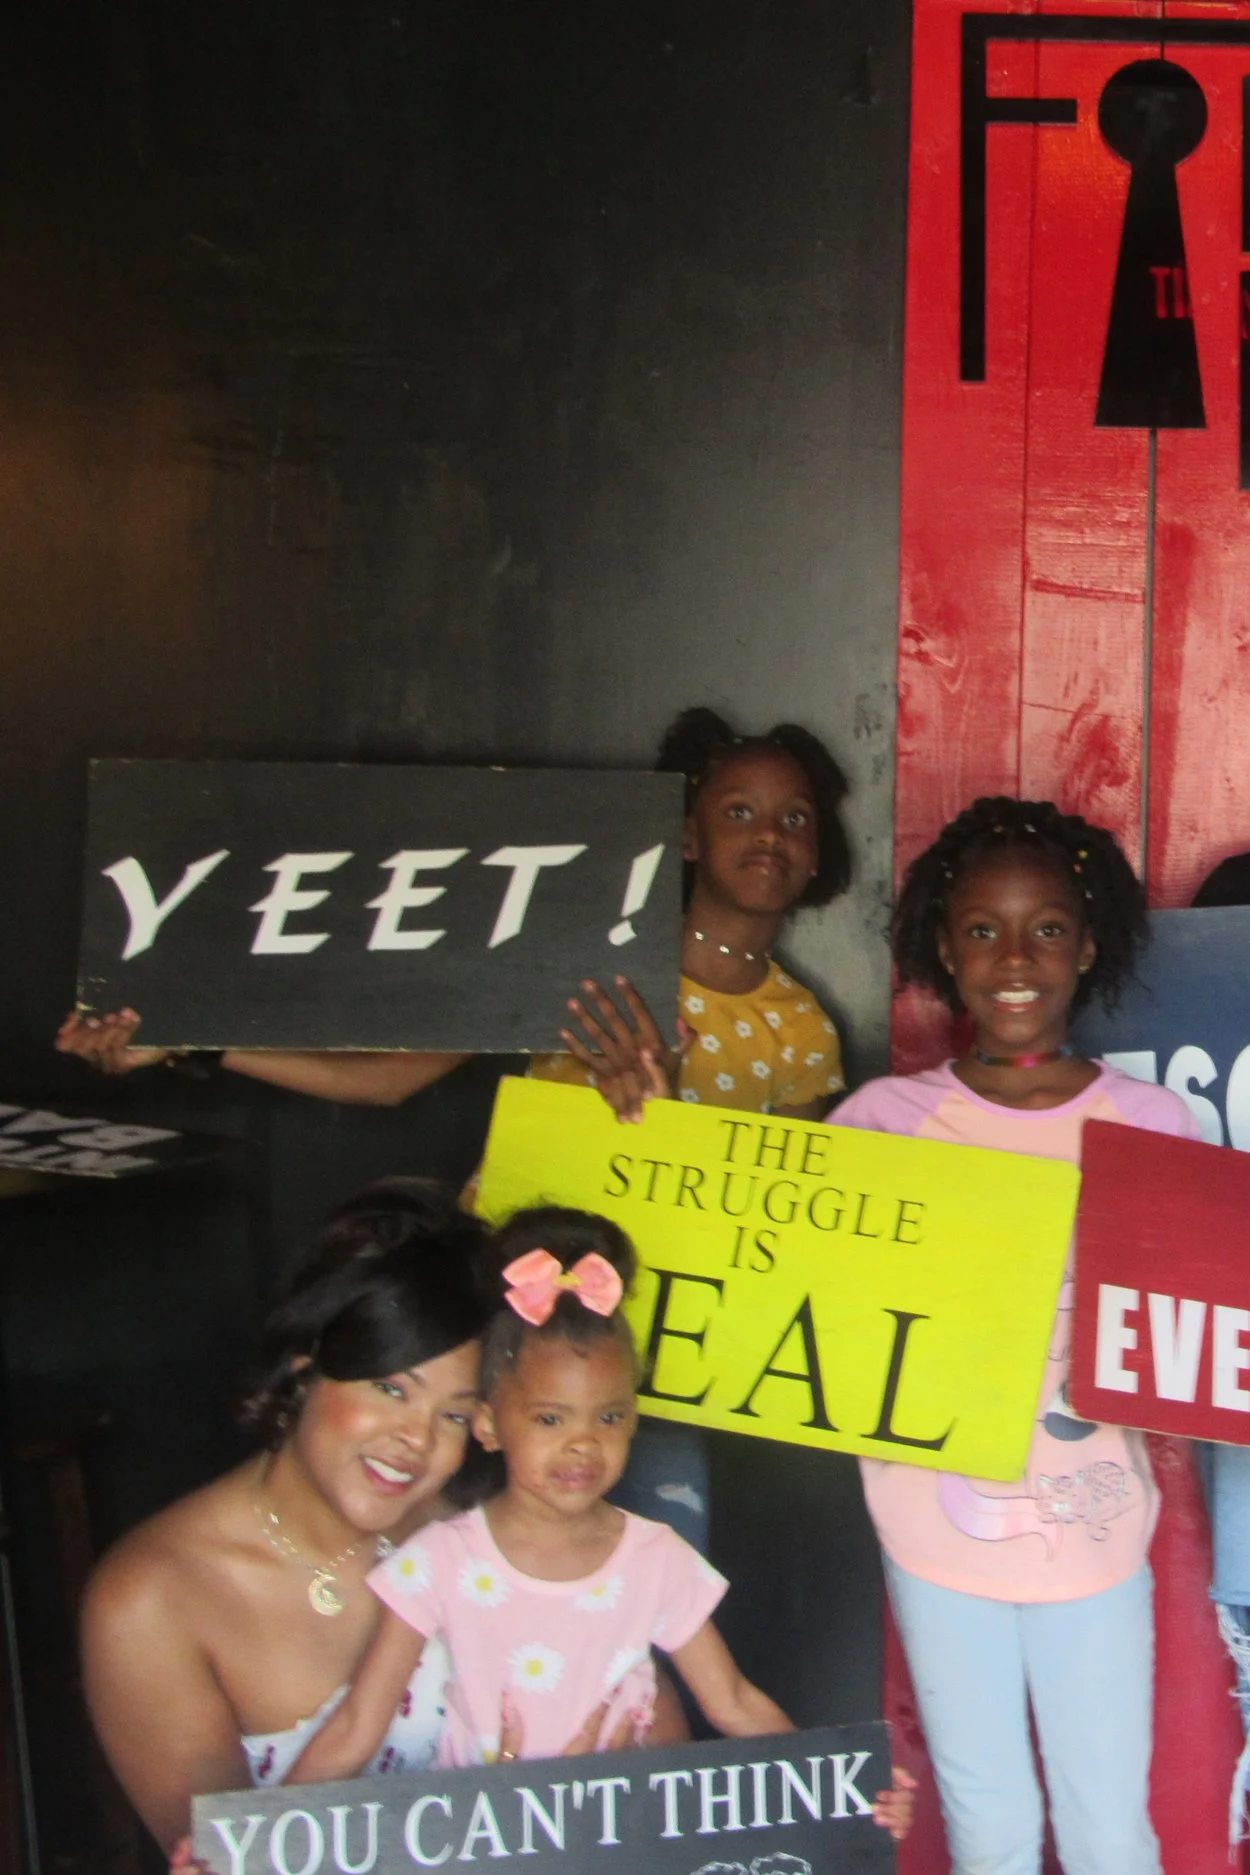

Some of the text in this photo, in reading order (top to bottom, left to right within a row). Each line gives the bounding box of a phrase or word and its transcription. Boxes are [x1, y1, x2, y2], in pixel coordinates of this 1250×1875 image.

[720, 1119, 833, 1177] THE
[603, 1153, 926, 1246] STRUGGLE
[728, 1226, 779, 1274] IS
[638, 1266, 959, 1453] EAL
[209, 1751, 876, 1875] YOU CAN'T THINK
